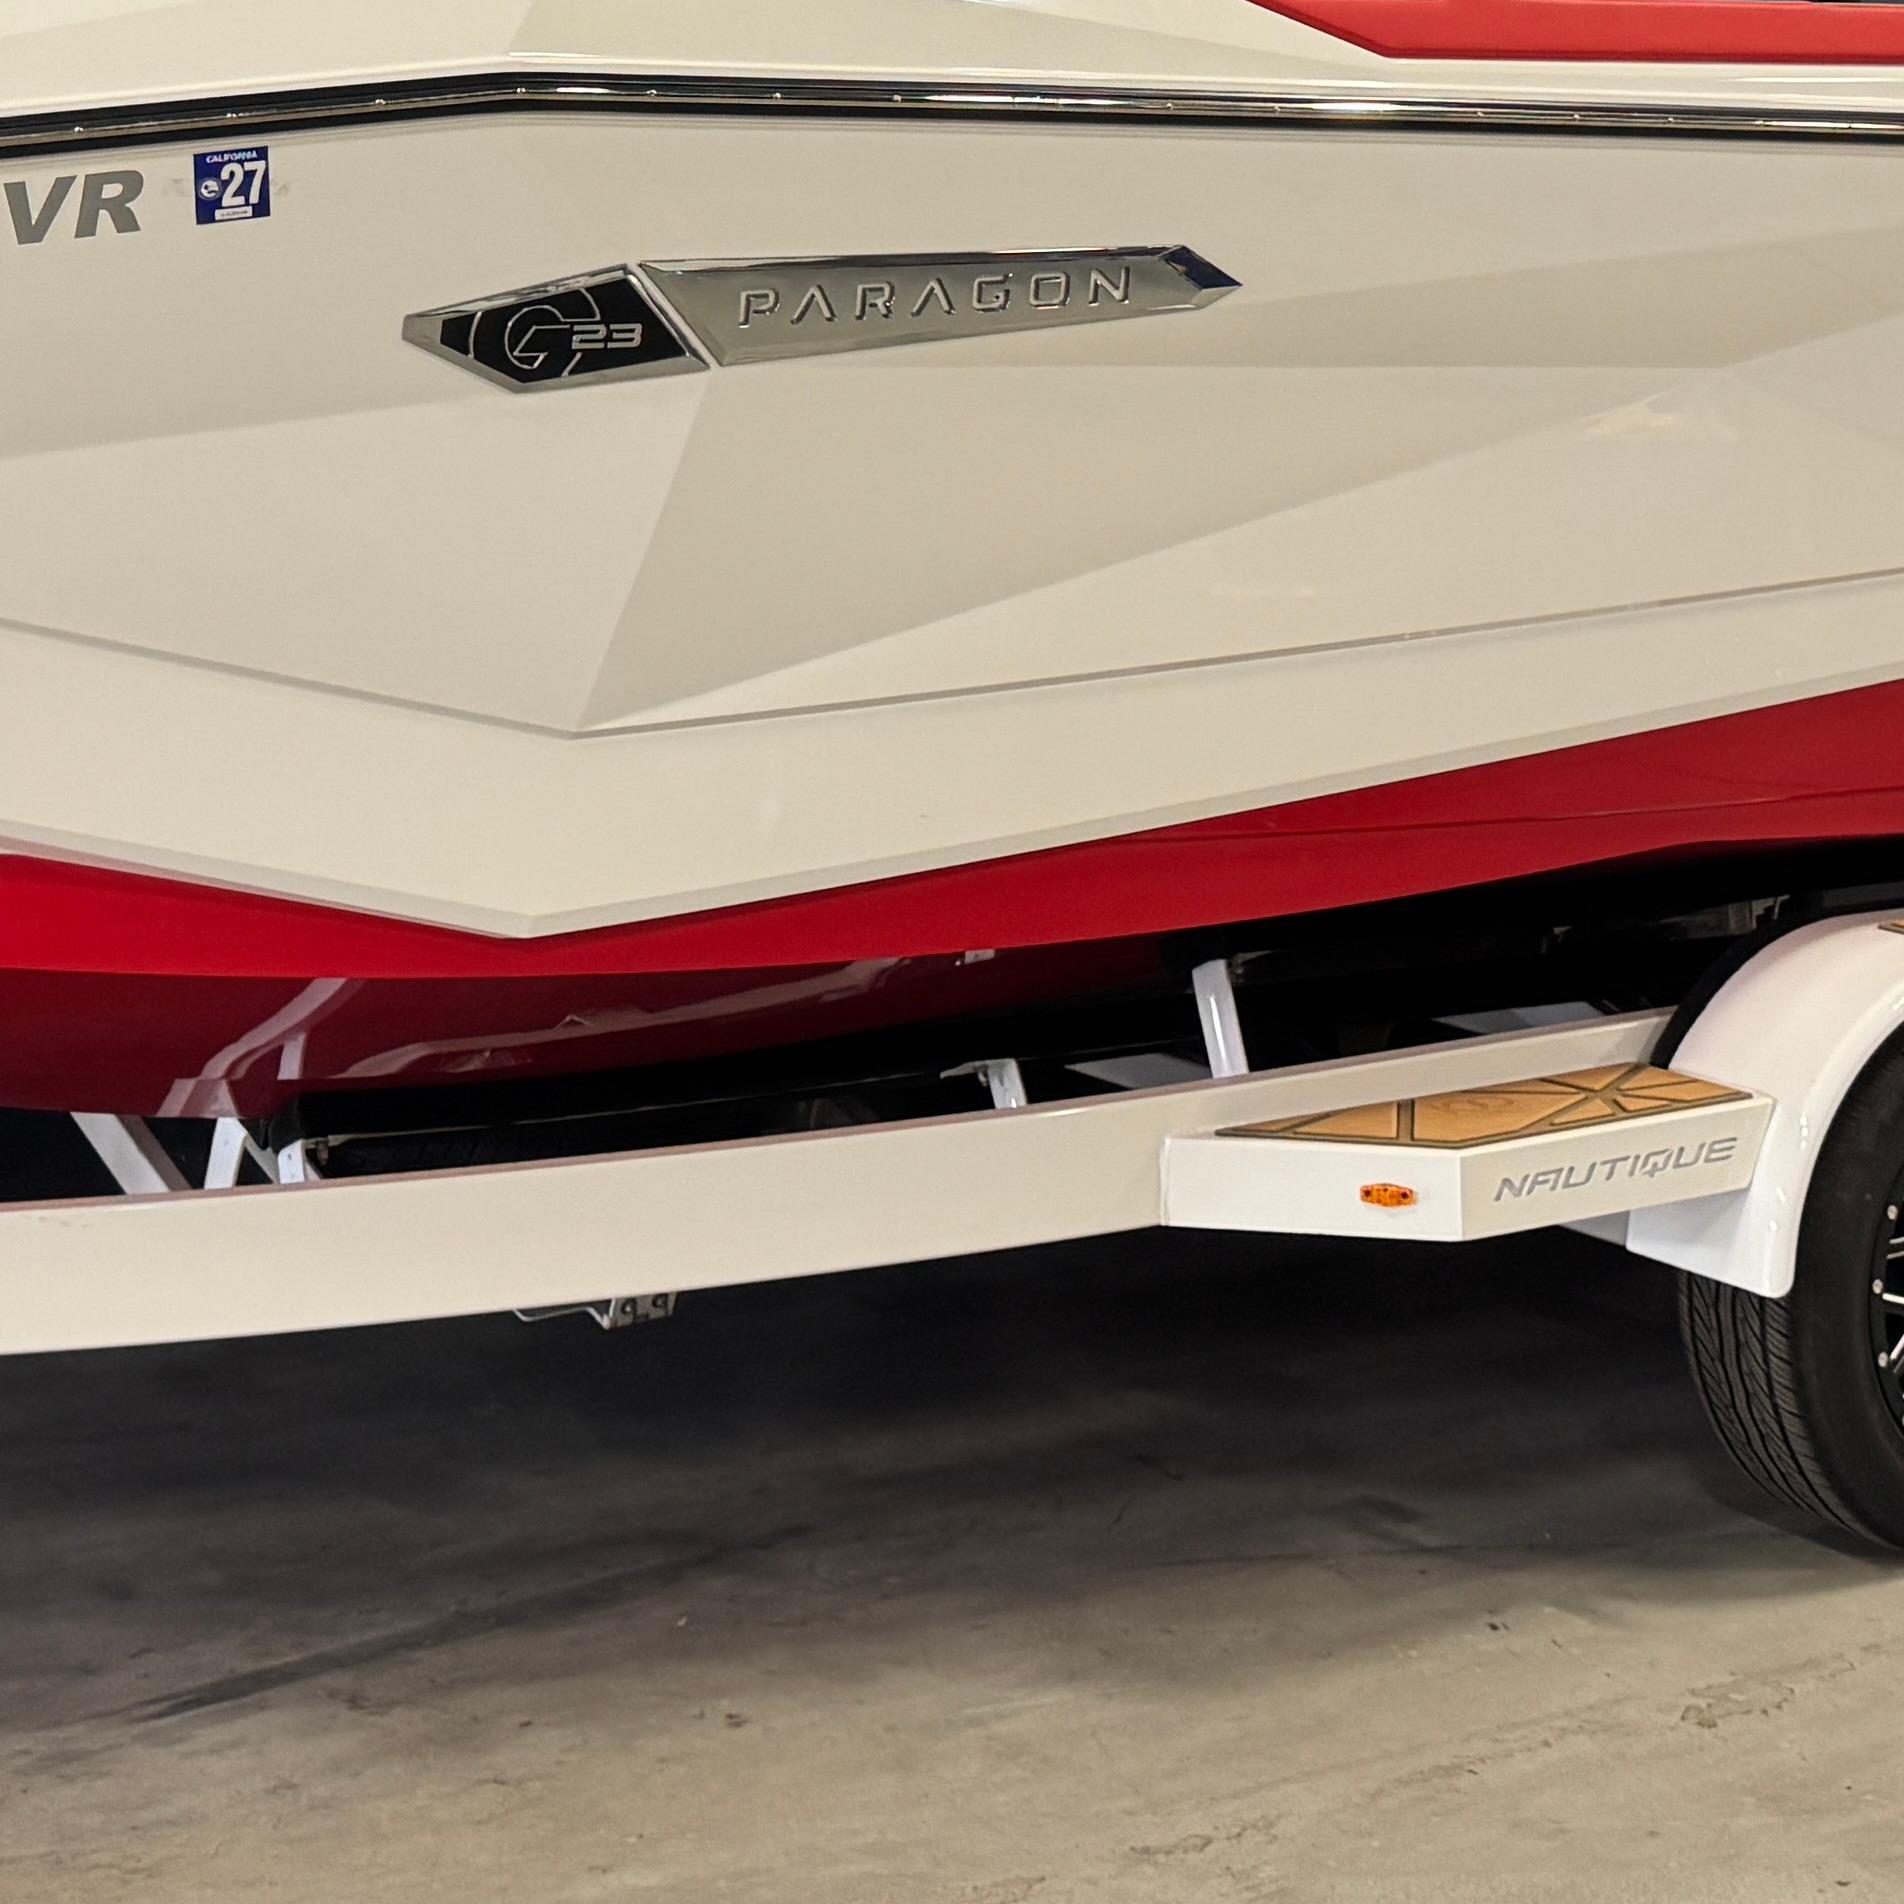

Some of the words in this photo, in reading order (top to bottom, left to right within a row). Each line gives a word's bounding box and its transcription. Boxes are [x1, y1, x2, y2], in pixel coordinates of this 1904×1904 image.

[3, 170, 144, 245] VR
[220, 159, 267, 208] 27
[738, 265, 1131, 329] PARAGON
[1493, 1136, 1738, 1202] NAUTIQUE
